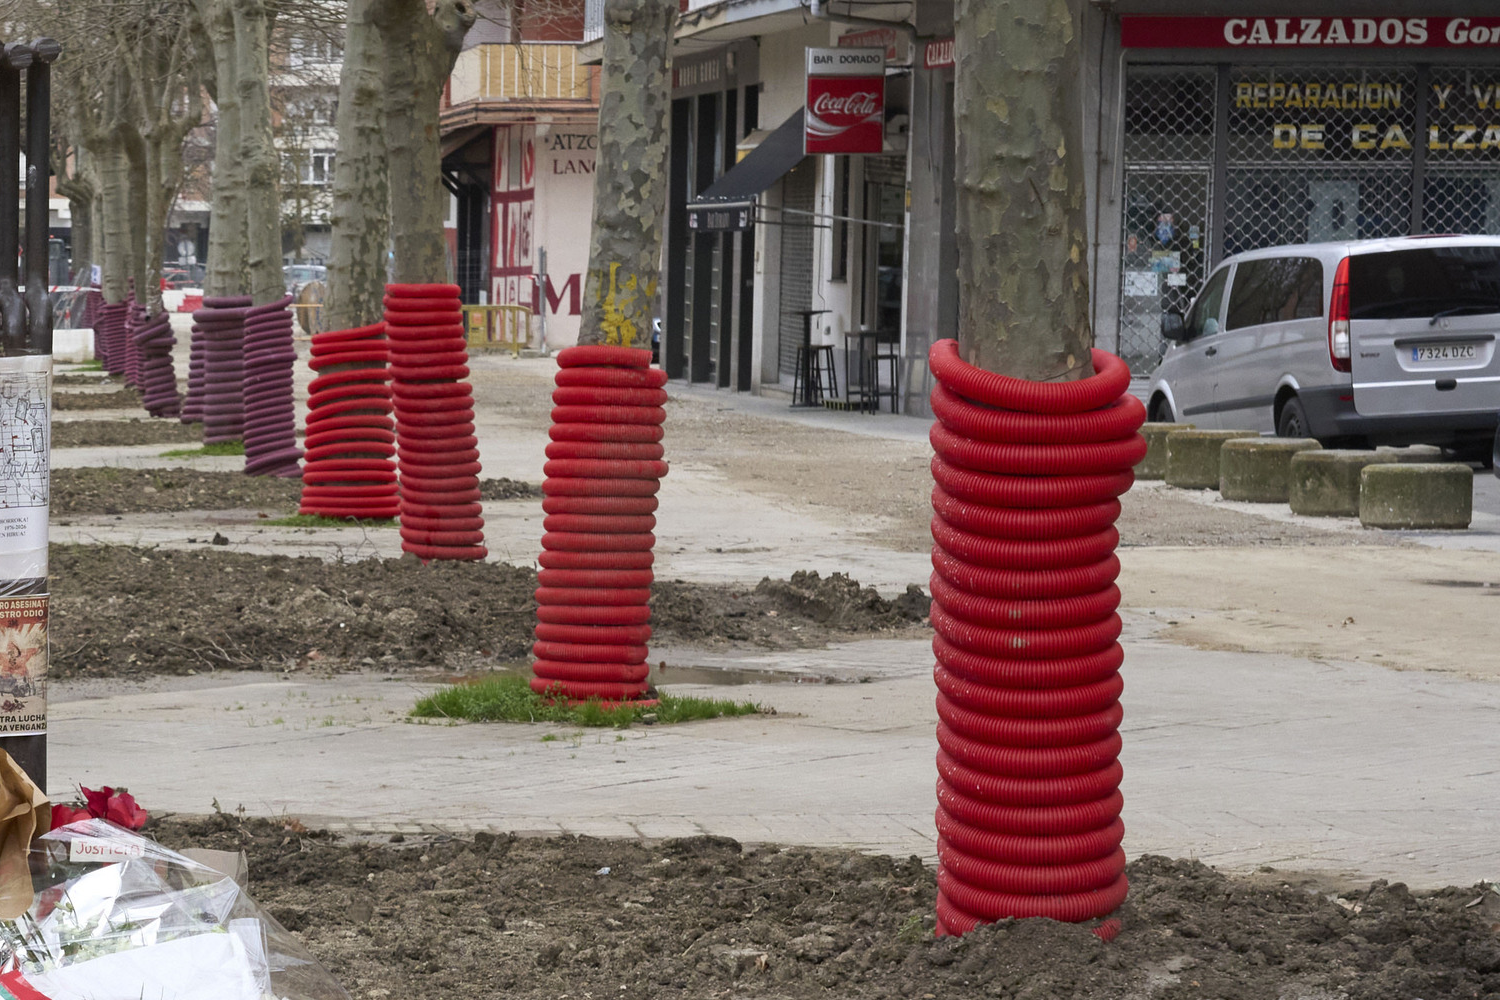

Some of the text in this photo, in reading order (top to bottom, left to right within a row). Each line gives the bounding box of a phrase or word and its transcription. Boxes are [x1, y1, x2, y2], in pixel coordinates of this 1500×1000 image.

[1224, 18, 1428, 44] CALZADOS
[814, 55, 880, 64] BAR DORADO
[1433, 84, 1452, 110] Y
[1273, 124, 1325, 149] DE
[1419, 346, 1474, 359] 7324 DZC
[23, 609, 44, 618] ODIO
[19, 714, 46, 722] LUCHA
